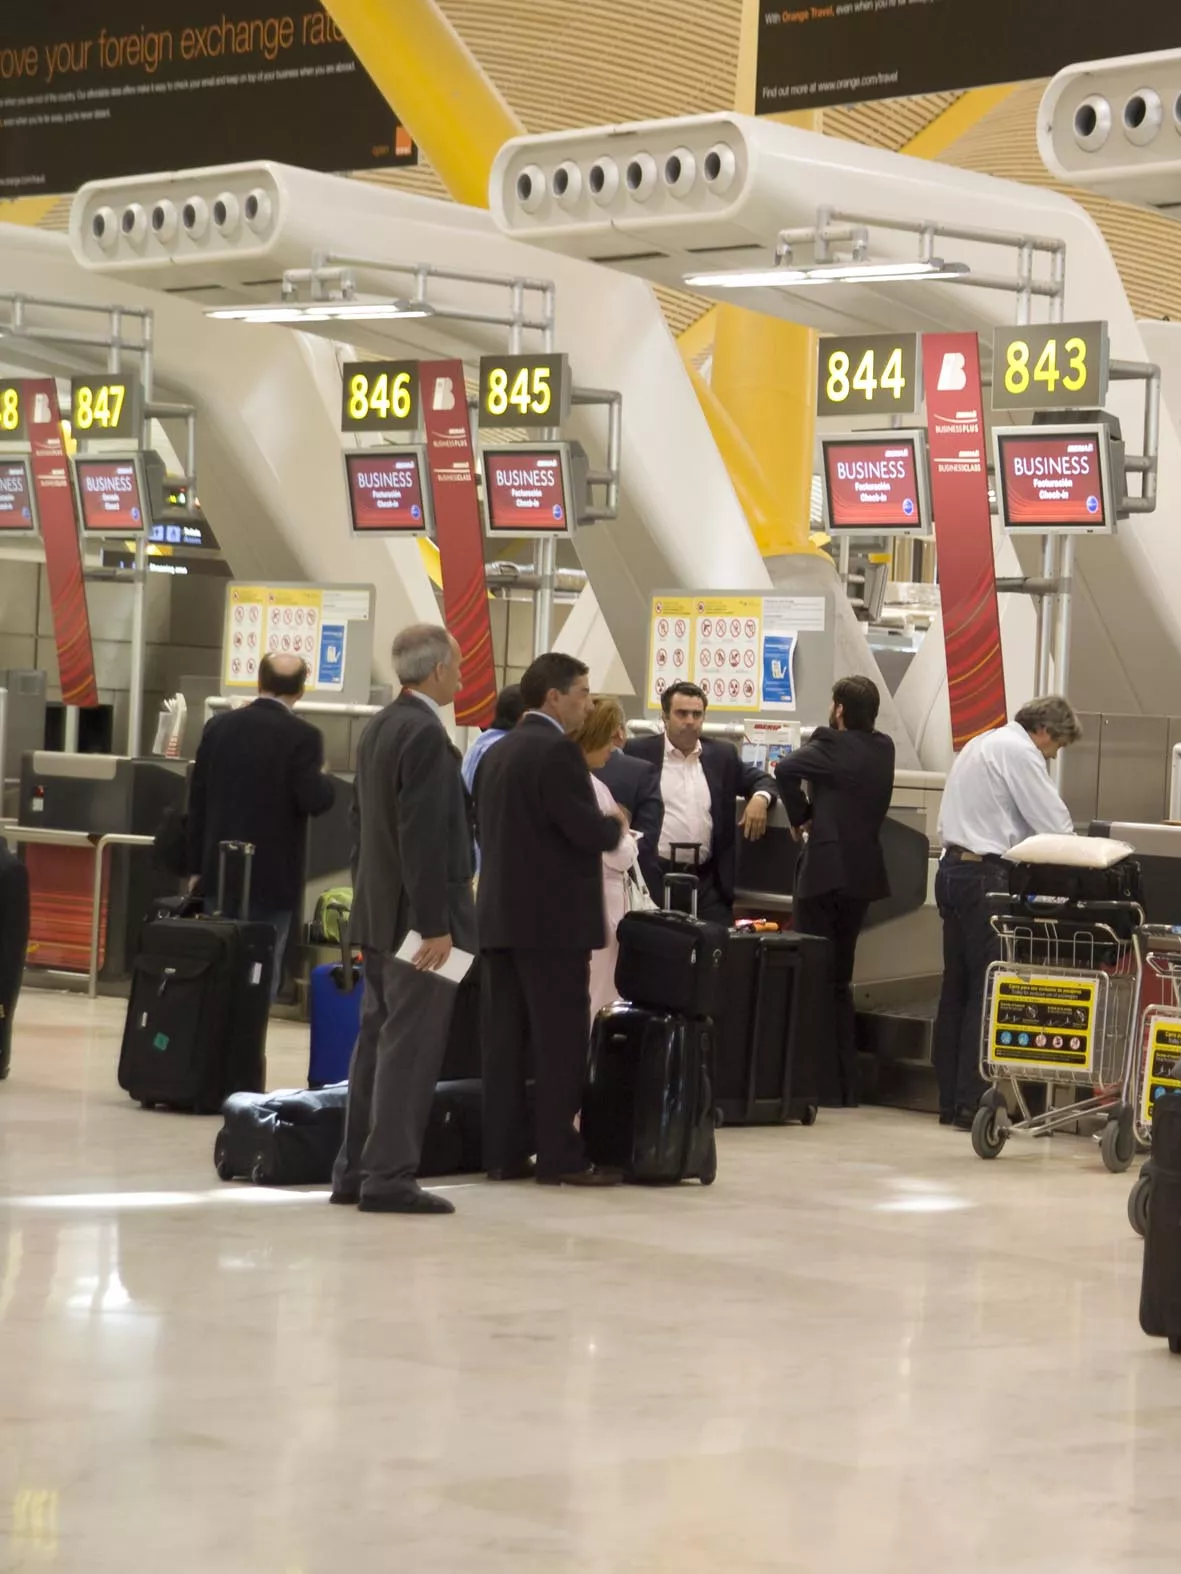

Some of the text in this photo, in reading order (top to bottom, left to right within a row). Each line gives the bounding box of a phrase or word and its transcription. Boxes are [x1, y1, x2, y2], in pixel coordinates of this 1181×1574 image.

[782, 10, 809, 24] Orange
[45, 40, 93, 83] your
[98, 24, 174, 73] foreign
[180, 13, 295, 60] exchange
[762, 87, 777, 99] Find
[826, 348, 906, 402] 844
[1004, 337, 1087, 394] 843
[350, 372, 411, 420] 846
[488, 367, 551, 415] 845
[0, 388, 19, 430] 8
[77, 385, 125, 429] 847
[358, 472, 413, 488] BUSINESS
[496, 470, 555, 487] BUSINESS
[837, 461, 906, 480] BUSINESS
[1013, 457, 1089, 476] BUSINESS
[85, 477, 132, 492] BUSINESS
